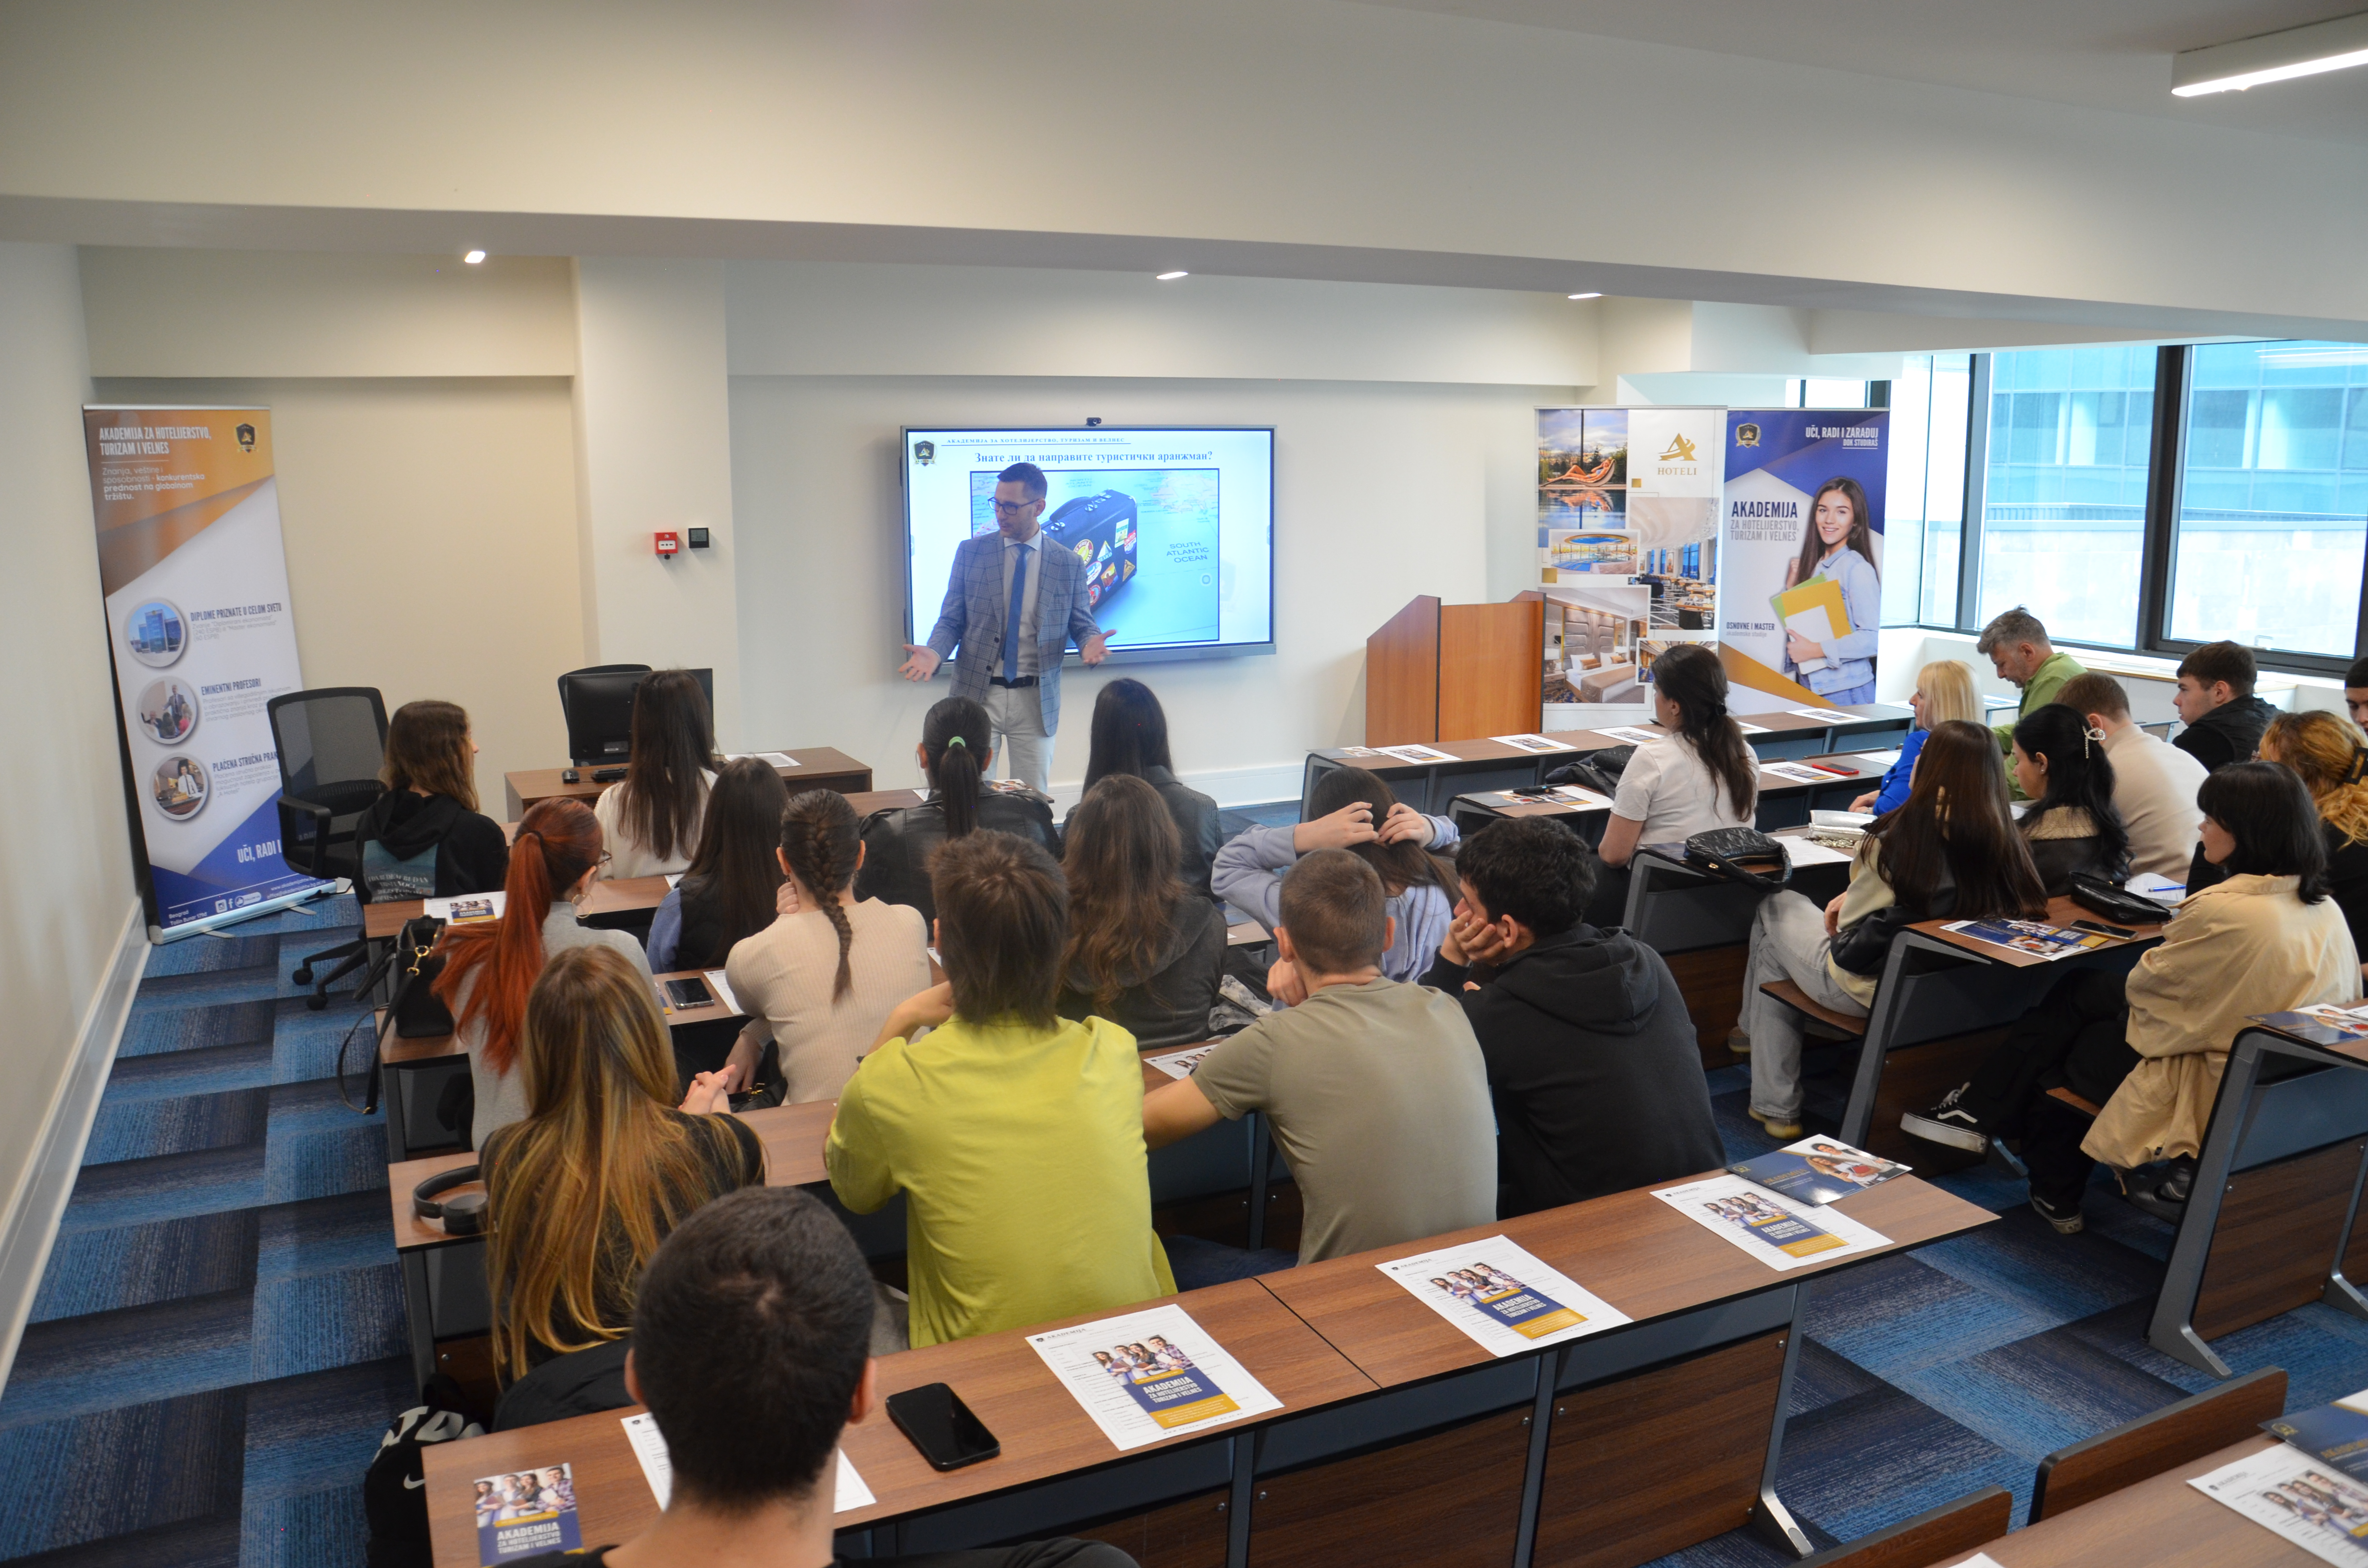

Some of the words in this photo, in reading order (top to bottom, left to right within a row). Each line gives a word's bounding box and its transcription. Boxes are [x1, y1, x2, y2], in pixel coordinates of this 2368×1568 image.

[99, 428, 143, 441] AKADEMIJA
[144, 427, 155, 440] ZA
[155, 427, 212, 441] HOTELIJERSTVO,
[1806, 425, 1820, 439] UČI,
[1822, 427, 1839, 438] RADI
[1841, 428, 1845, 438] I
[1846, 427, 1878, 438] ZARAĐUJ
[99, 442, 135, 456] TURIZAM
[137, 442, 141, 454] I
[142, 441, 169, 454] VELNES
[1854, 438, 1878, 447] STUDIRAŠ
[975, 453, 1005, 463] Знате
[1024, 453, 1036, 464] да
[1038, 453, 1093, 465] направите
[1095, 453, 1155, 464] туристички
[1158, 451, 1212, 461] аранжман?
[156, 473, 205, 481] konkurentska
[1658, 467, 1697, 476] HOTELI
[104, 483, 142, 493] prednost
[155, 481, 193, 491] globalnom
[1731, 501, 1798, 518] AKADEMIJA
[1730, 519, 1739, 529] ZA
[1742, 520, 1799, 532] HOTELIJERSTVO,
[1730, 530, 1762, 541] TURIZAM
[1764, 530, 1767, 541] I
[1770, 531, 1797, 541] VELNES
[1166, 547, 1209, 556] ATLANTIC
[1174, 554, 1208, 563] OCEAN
[190, 610, 216, 622] DIPLOME
[217, 607, 242, 619] PRIZNATE
[243, 606, 247, 615] U
[248, 604, 266, 615] CELOM
[267, 602, 282, 612] SVETU
[1727, 622, 1750, 630] OSNOVNE
[201, 682, 232, 695] EMINENTNI
[233, 678, 261, 691] PROFESORI
[239, 753, 262, 766] STRUČNA
[263, 751, 278, 762] PRAK
[237, 844, 256, 863] UČI,
[256, 840, 277, 859] RADI
[277, 839, 282, 853] I
[1761, 1220, 1800, 1234] AKADEMIJA
[1400, 1258, 1432, 1268] AKADEMIJA
[1492, 1294, 1535, 1311] AKADEMIJA
[1047, 1328, 1086, 1339] AKADEMIJA
[1143, 1376, 1194, 1394] AKADEMIJA
[1152, 1394, 1178, 1404] TURIZAM
[1180, 1386, 1203, 1396] VELNES
[497, 1521, 560, 1541] AKADEMIJA
[498, 1543, 530, 1555] TURIZAM
[535, 1536, 562, 1547] VELNES
